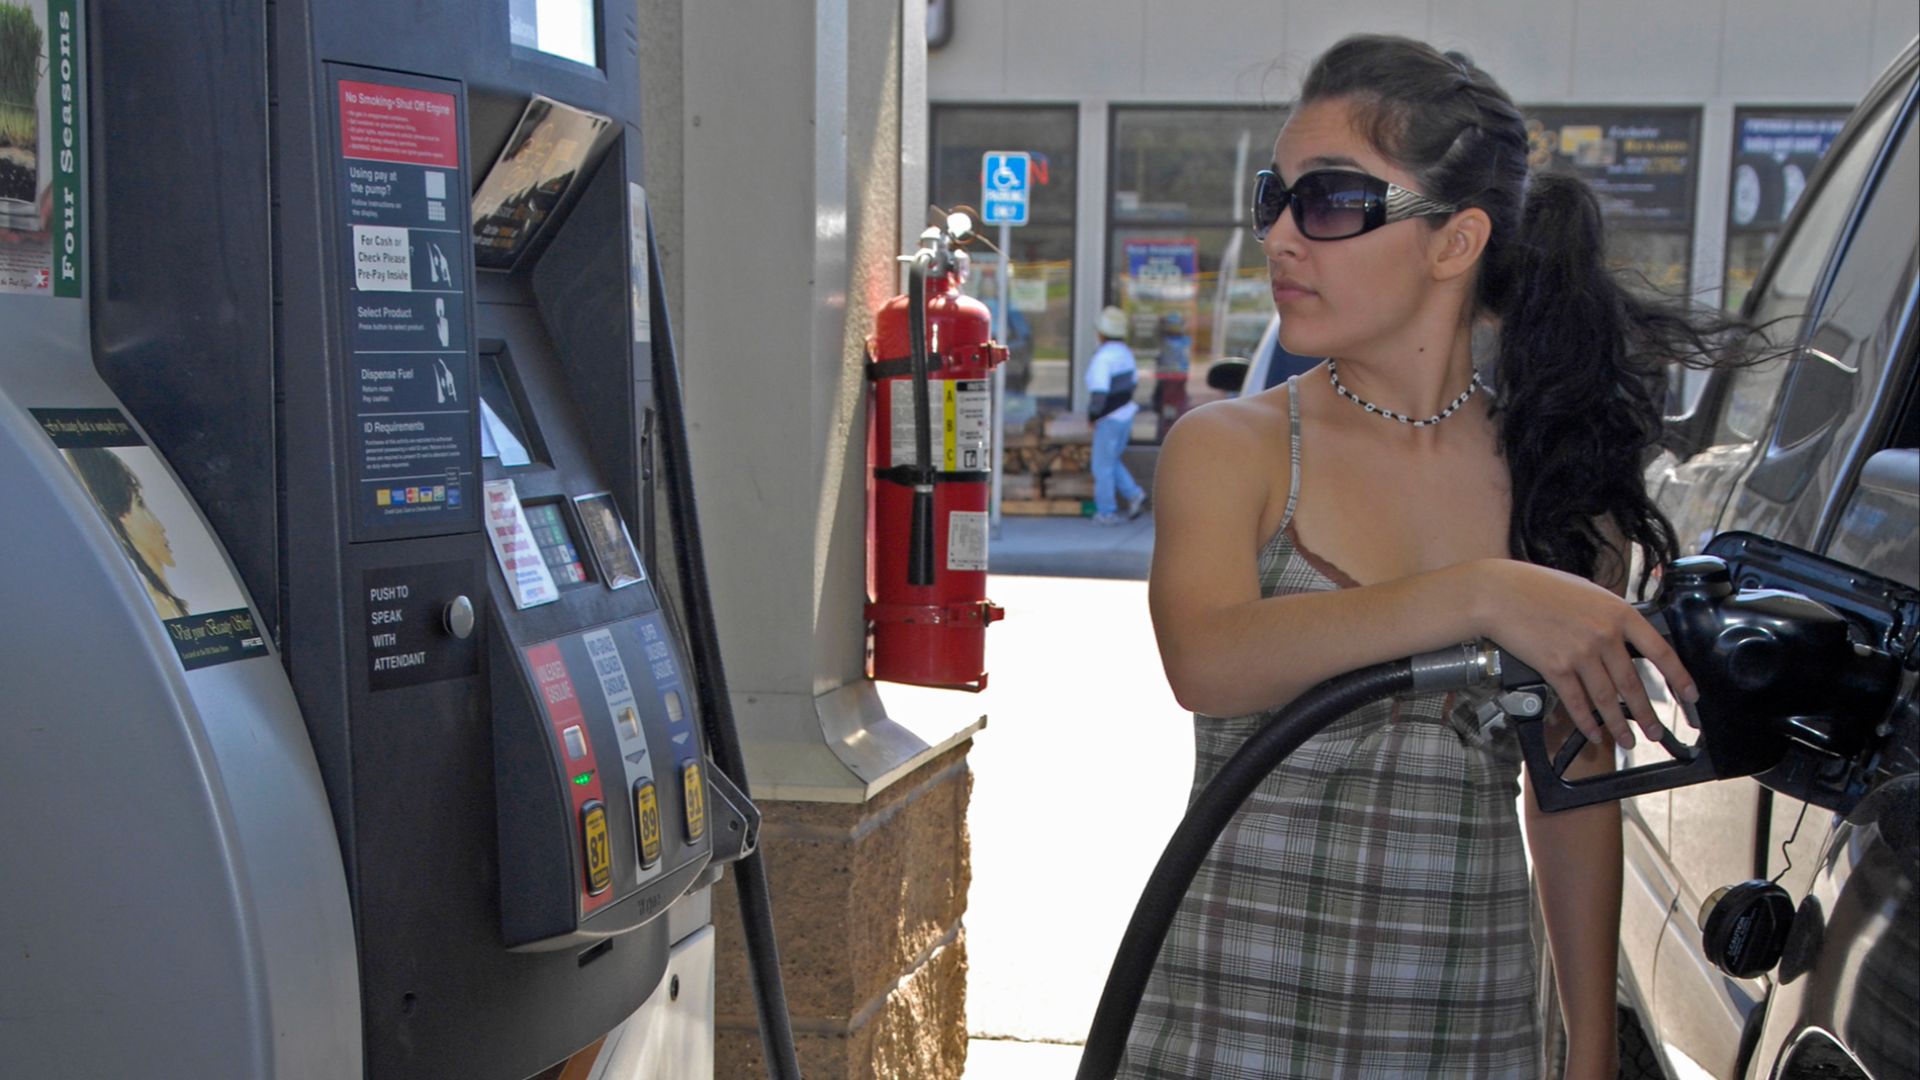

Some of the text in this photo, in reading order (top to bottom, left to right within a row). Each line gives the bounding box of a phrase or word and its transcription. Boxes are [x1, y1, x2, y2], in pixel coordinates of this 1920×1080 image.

[345, 92, 357, 103] No
[414, 100, 425, 110] Off
[426, 102, 450, 115] Engine
[59, 10, 76, 281] Four Seasons
[349, 167, 398, 183] Using pay at
[350, 182, 392, 197] the pump?
[361, 235, 402, 247] For Cash or
[358, 252, 406, 265] Check Please
[358, 269, 408, 282] Pre-Pay Inside
[357, 306, 413, 318] Select Product
[361, 369, 414, 381] Dispense Fuel
[946, 390, 953, 402] A
[364, 421, 425, 434] ID Requirements
[946, 419, 953, 432] B
[946, 449, 953, 461] C
[370, 585, 409, 601] PUSH TO
[371, 609, 402, 624] SPEAK
[372, 633, 397, 648] WITH
[645, 641, 668, 662] UNLEADED
[374, 652, 426, 671] ATTENDANT
[595, 655, 622, 676] UNLEADED
[652, 659, 674, 680] GASOLINE
[536, 661, 566, 683] UNLEADED
[545, 681, 573, 704] GASOLINE
[602, 674, 629, 696] GASOLINE
[687, 788, 701, 818] 91
[641, 807, 657, 840] 89
[589, 832, 607, 869] 87
